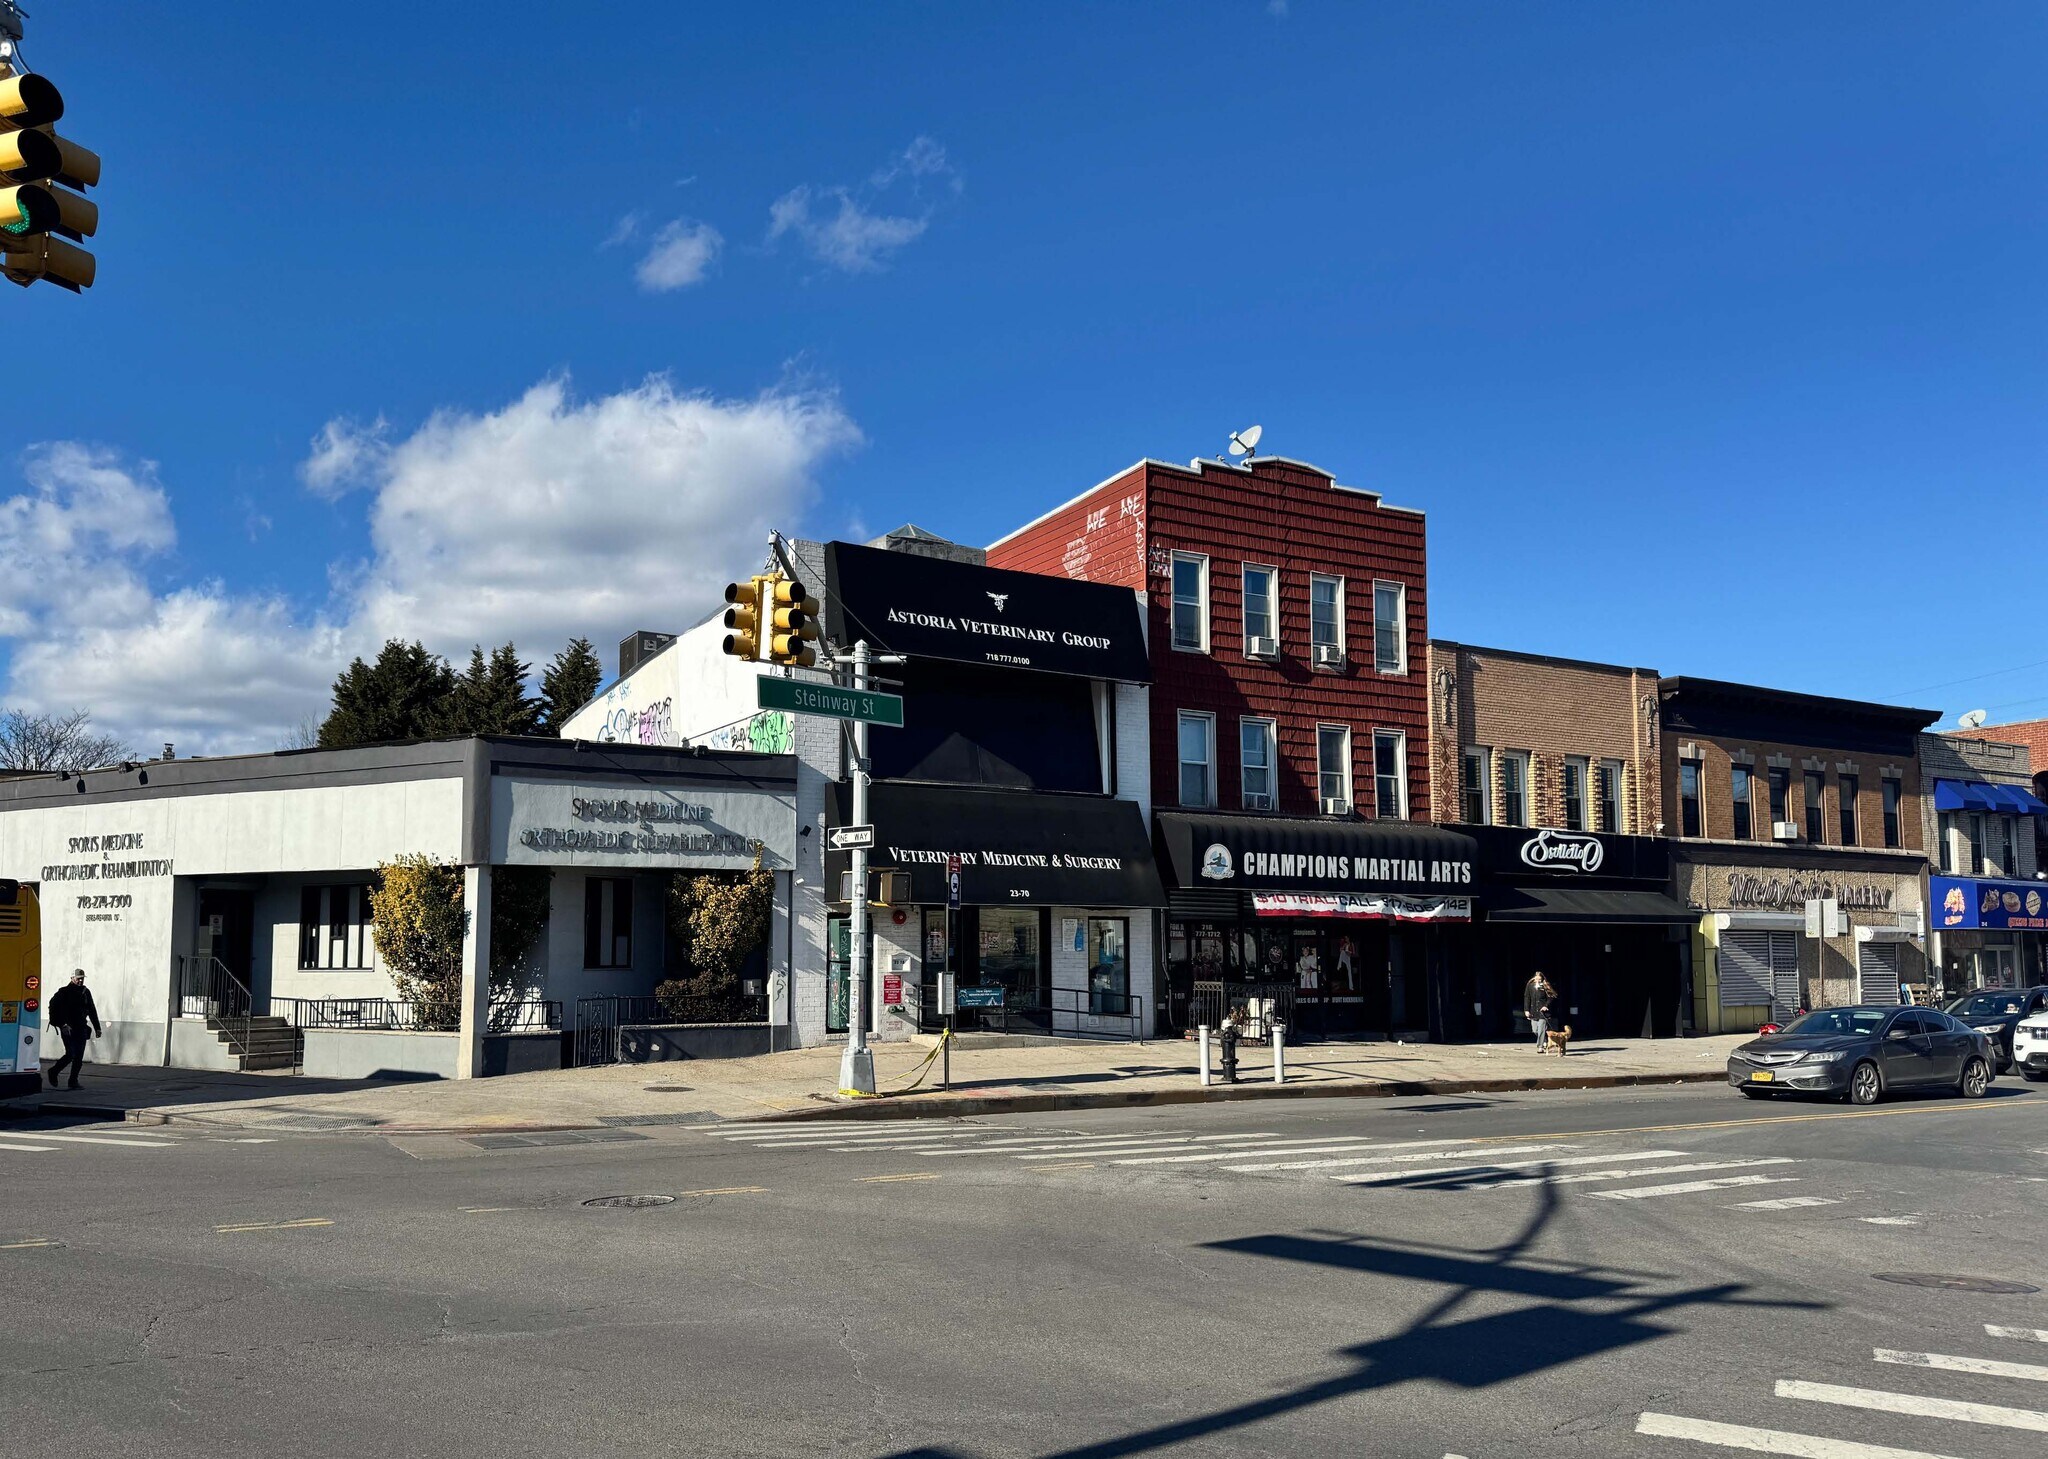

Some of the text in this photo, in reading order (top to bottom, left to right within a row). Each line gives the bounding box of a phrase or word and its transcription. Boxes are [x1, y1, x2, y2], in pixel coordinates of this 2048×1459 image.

[887, 607, 1111, 651] ASTORIA VETERINARY GROUP
[795, 689, 875, 715] Steinway St
[572, 798, 708, 823] SPORTS MEDICINE
[68, 832, 144, 853] SPORTS MEDICINE
[520, 828, 631, 850] ORTHOPAEDIC
[837, 832, 868, 843] ONE WAY
[889, 847, 977, 865] VETERINRY
[983, 851, 1048, 867] MEDICINE
[1052, 855, 1062, 867] &
[1065, 854, 1122, 870] SURGERY
[1243, 852, 1349, 879] CHAMPIONS
[1354, 858, 1426, 882] MARTIAL
[1431, 861, 1471, 883] ARTS
[41, 859, 174, 882] ORTHOPAEDIC REHABILITATION
[1010, 889, 1030, 897] 23-70
[1341, 896, 1377, 907] CALL
